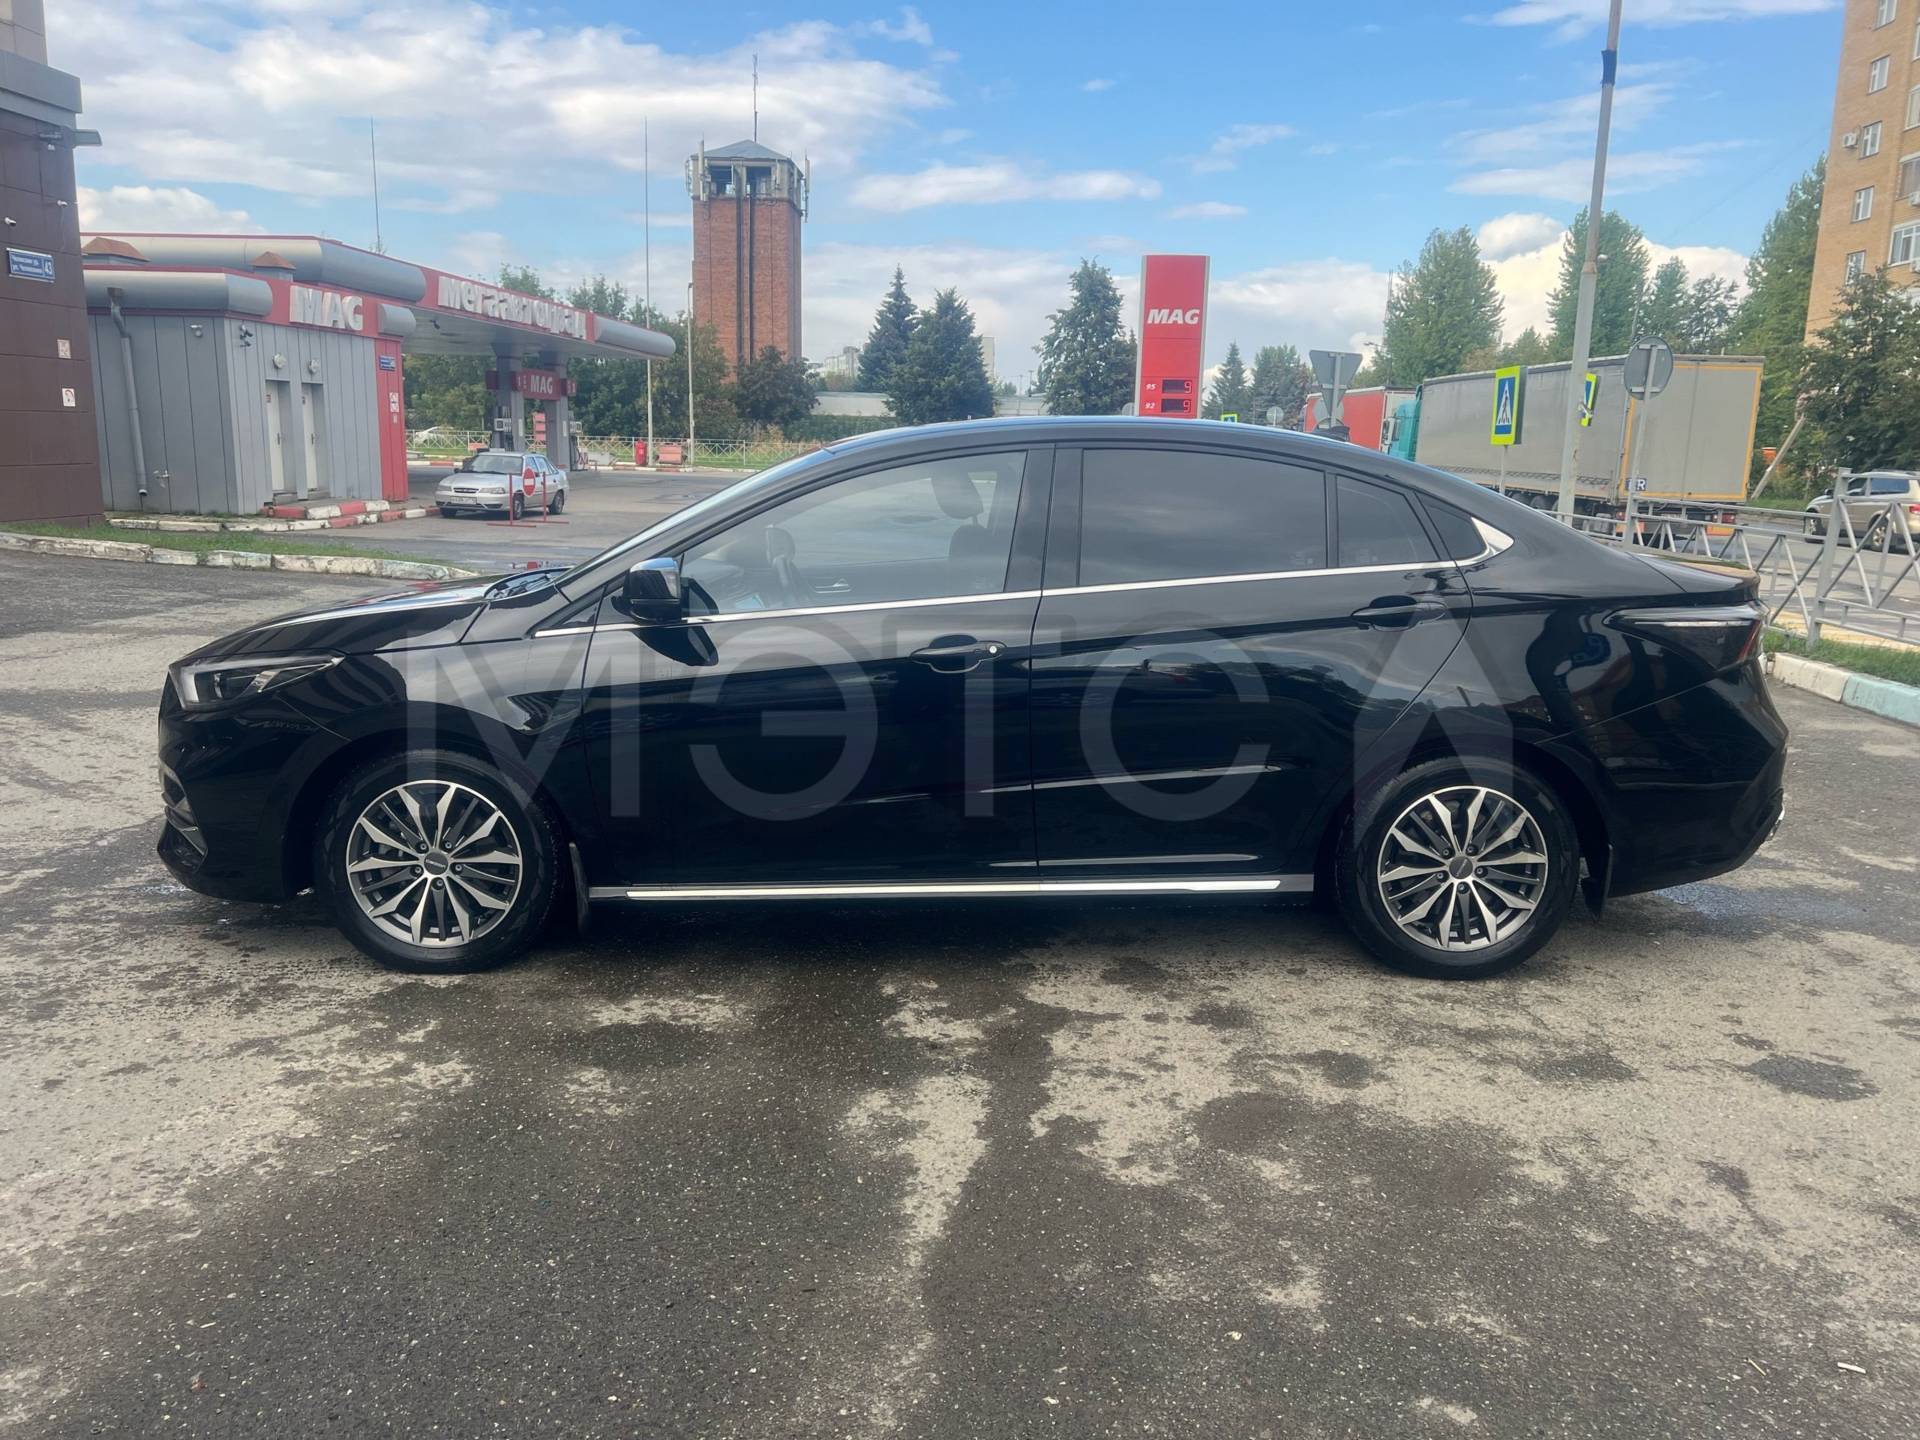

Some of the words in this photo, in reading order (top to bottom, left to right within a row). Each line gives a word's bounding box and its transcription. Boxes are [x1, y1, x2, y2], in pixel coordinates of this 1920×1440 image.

[289, 285, 363, 331] MAG
[1146, 309, 1200, 325] MAG
[530, 374, 553, 394] MAG
[1145, 402, 1155, 410] 92
